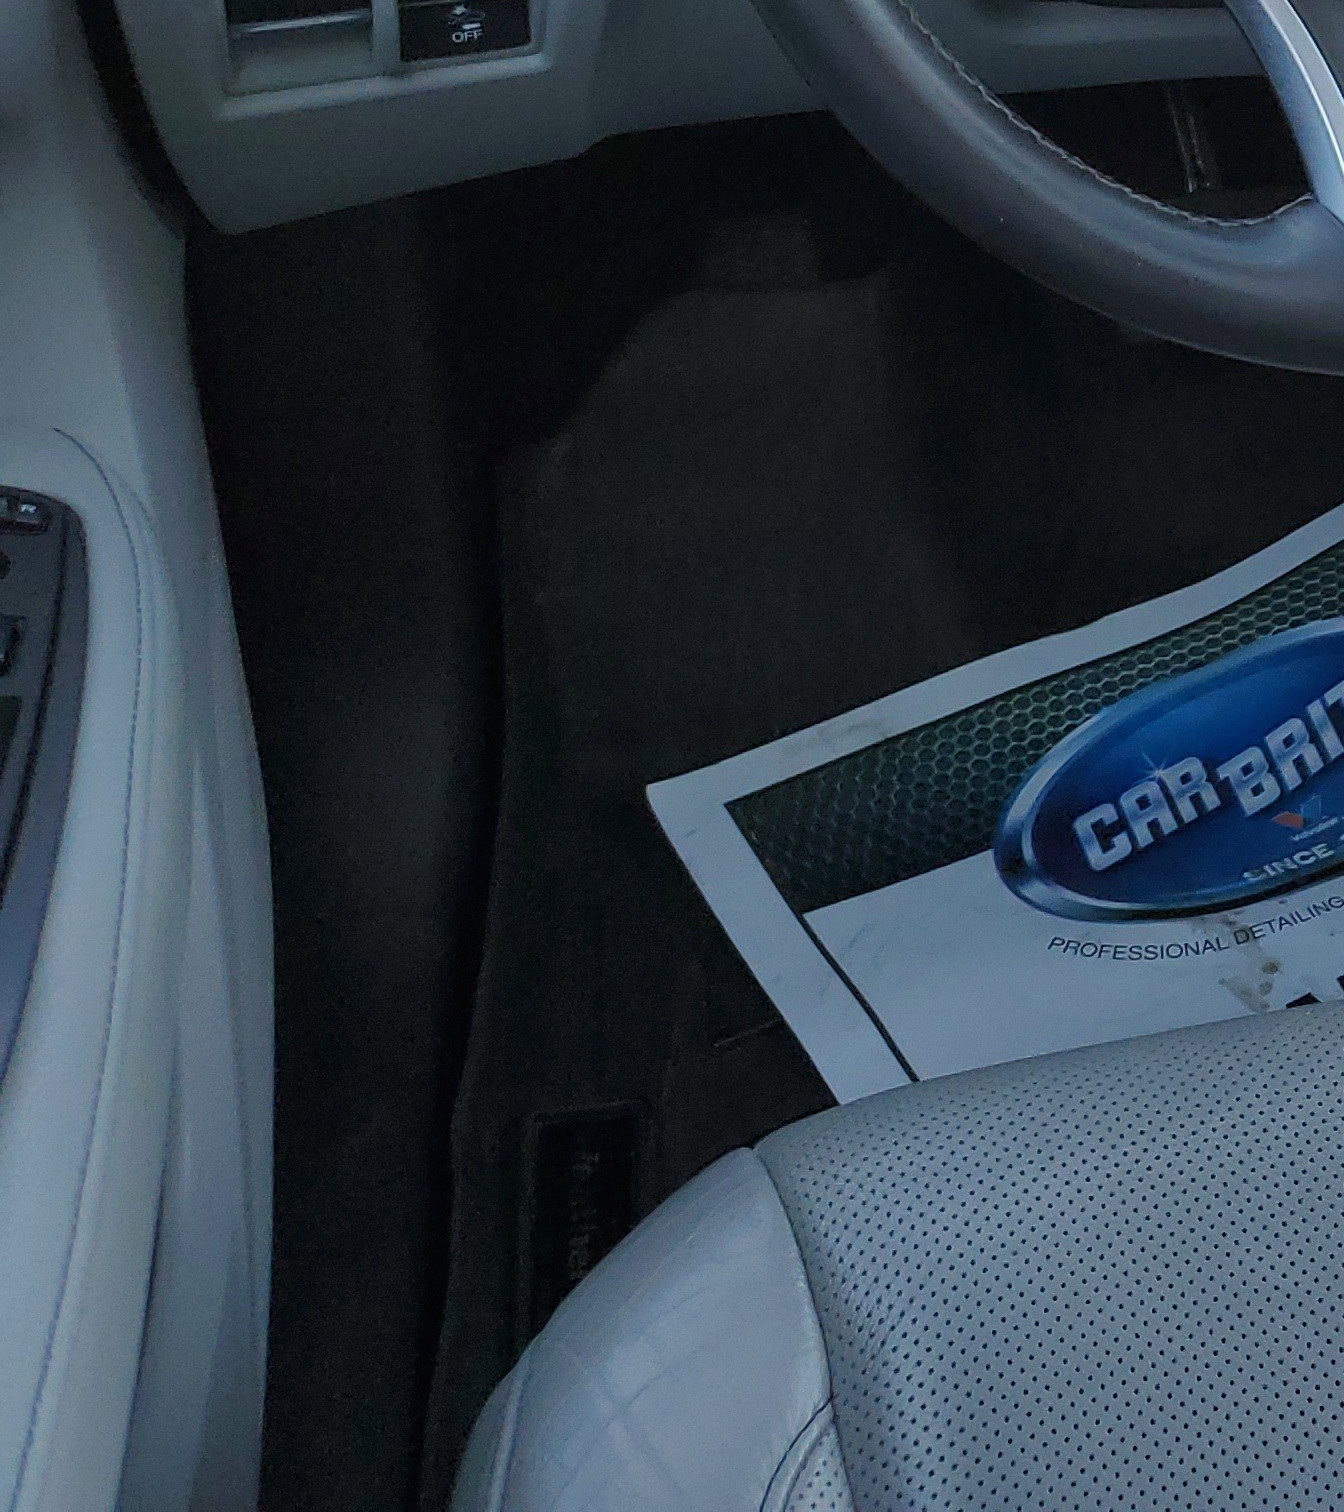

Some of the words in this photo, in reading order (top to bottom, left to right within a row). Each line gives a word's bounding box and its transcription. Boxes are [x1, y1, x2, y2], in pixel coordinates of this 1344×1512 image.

[451, 29, 484, 44] OFF
[1071, 755, 1222, 872] CAR
[1243, 842, 1336, 881] SINCE
[1047, 935, 1230, 961] PROFESSIONAL
